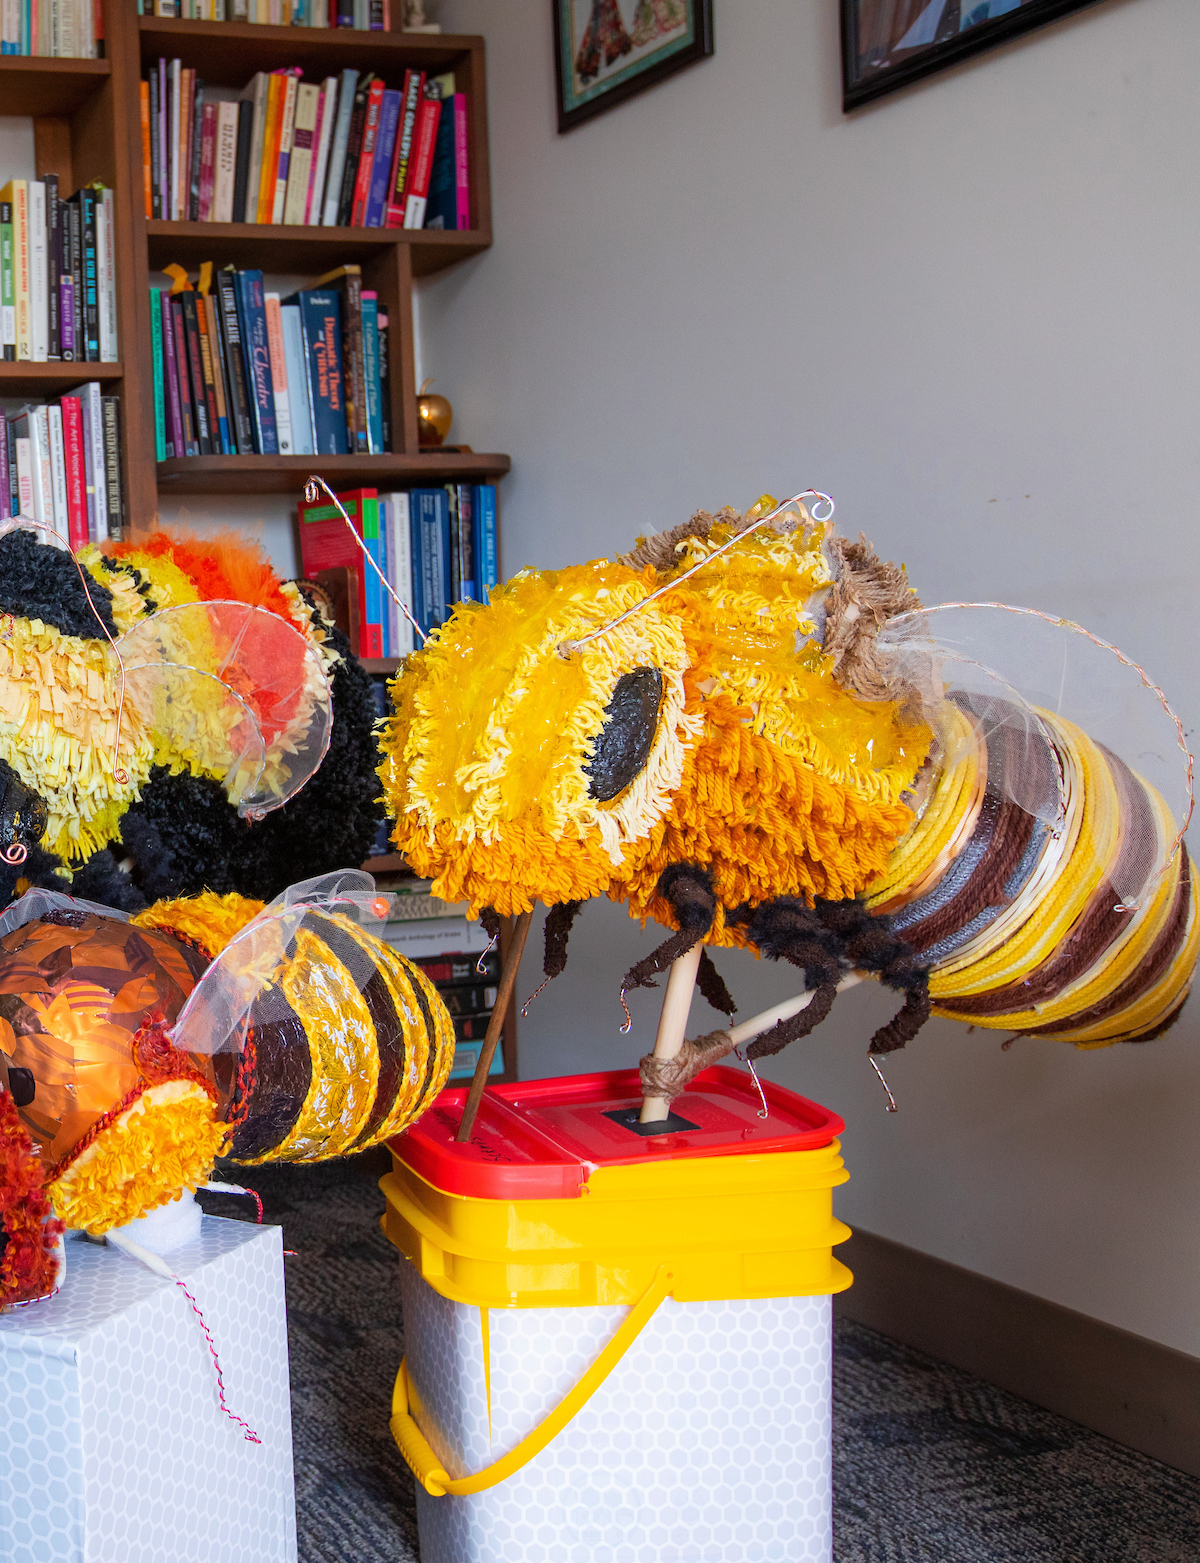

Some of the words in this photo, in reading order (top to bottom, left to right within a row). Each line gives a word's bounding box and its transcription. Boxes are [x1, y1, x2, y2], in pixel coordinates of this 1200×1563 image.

[406, 74, 420, 110] BLACK
[86, 248, 95, 259] THE
[86, 260, 96, 278] ACTOR
[87, 279, 96, 287] AT
[63, 289, 73, 322] Augusto
[88, 288, 96, 305] WORK
[222, 286, 237, 312] LIVING
[65, 325, 74, 346] Boal
[226, 314, 240, 344] THEATRE
[324, 316, 338, 369] Dramatic
[200, 334, 213, 385] PERFORMANCE
[314, 341, 328, 397] Criticism
[254, 346, 270, 409] Theatre
[328, 370, 340, 412] Theory
[70, 412, 78, 428] The
[92, 390, 100, 445] PSYCHOPHYSICAL
[105, 402, 116, 454] IMPROVISATION
[71, 430, 79, 442] Art
[72, 444, 79, 452] of
[40, 459, 49, 490] Respect
[72, 454, 80, 476] Voice
[108, 454, 117, 467] FOR
[108, 467, 118, 481] THE
[10, 464, 18, 494] REVEALED
[73, 478, 82, 504] Acting
[110, 482, 120, 514] THEATER
[348, 1041, 357, 1070] LINDOR
